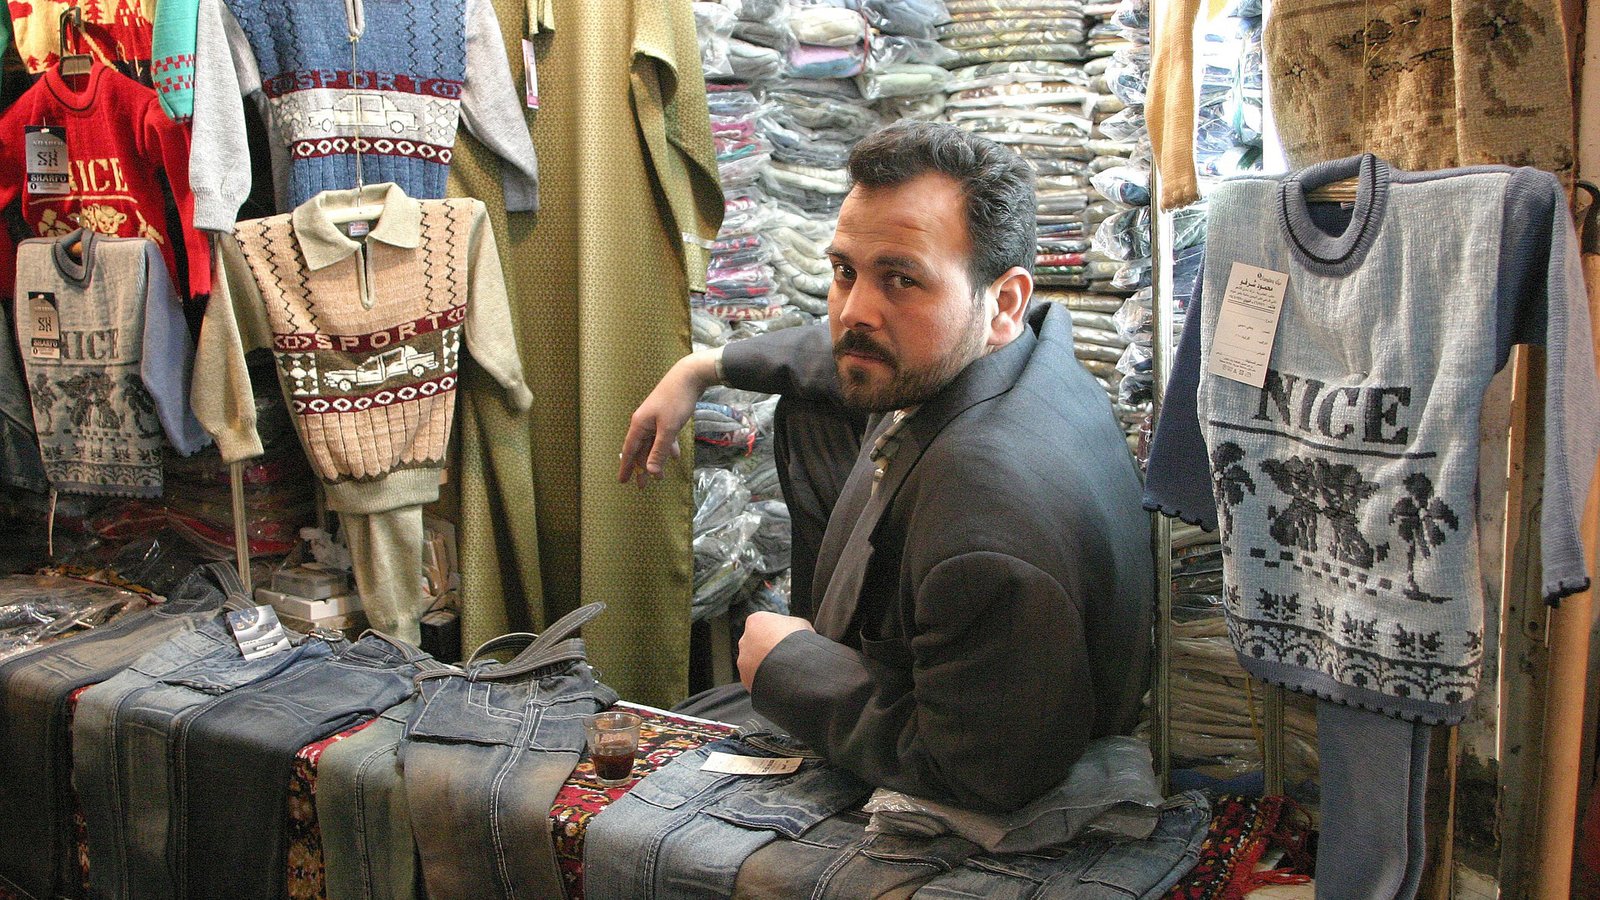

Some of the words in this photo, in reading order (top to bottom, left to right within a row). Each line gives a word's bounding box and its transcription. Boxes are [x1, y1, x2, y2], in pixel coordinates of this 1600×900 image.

[295, 69, 424, 94] SPORT
[315, 313, 443, 351] SPORT
[1251, 367, 1412, 446] NICE
